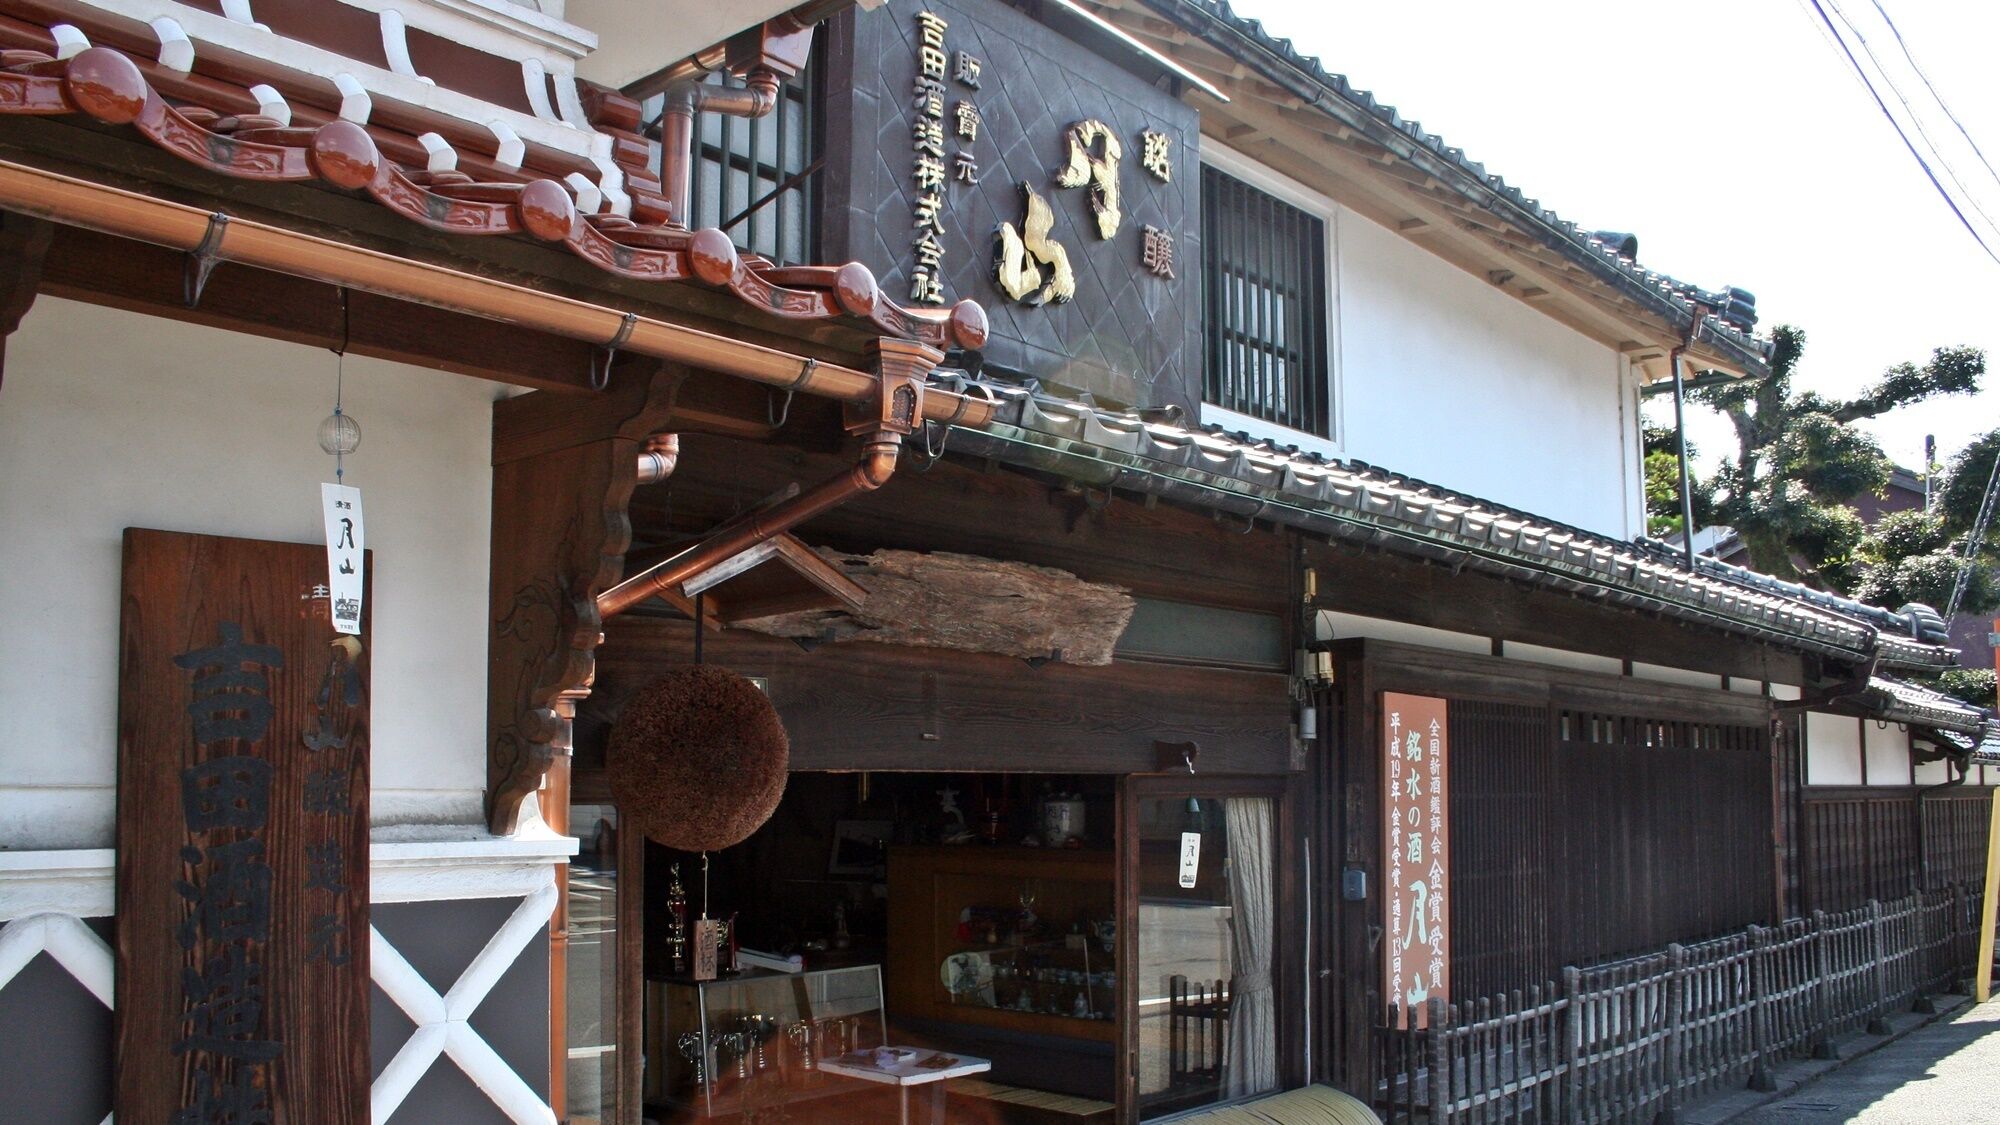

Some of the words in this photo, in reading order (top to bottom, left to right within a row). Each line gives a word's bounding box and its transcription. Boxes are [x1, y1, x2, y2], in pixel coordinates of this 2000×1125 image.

[910, 10, 948, 304] 吉田酒造株式会社
[991, 119, 1123, 307] 月山
[337, 518, 355, 575] 月山
